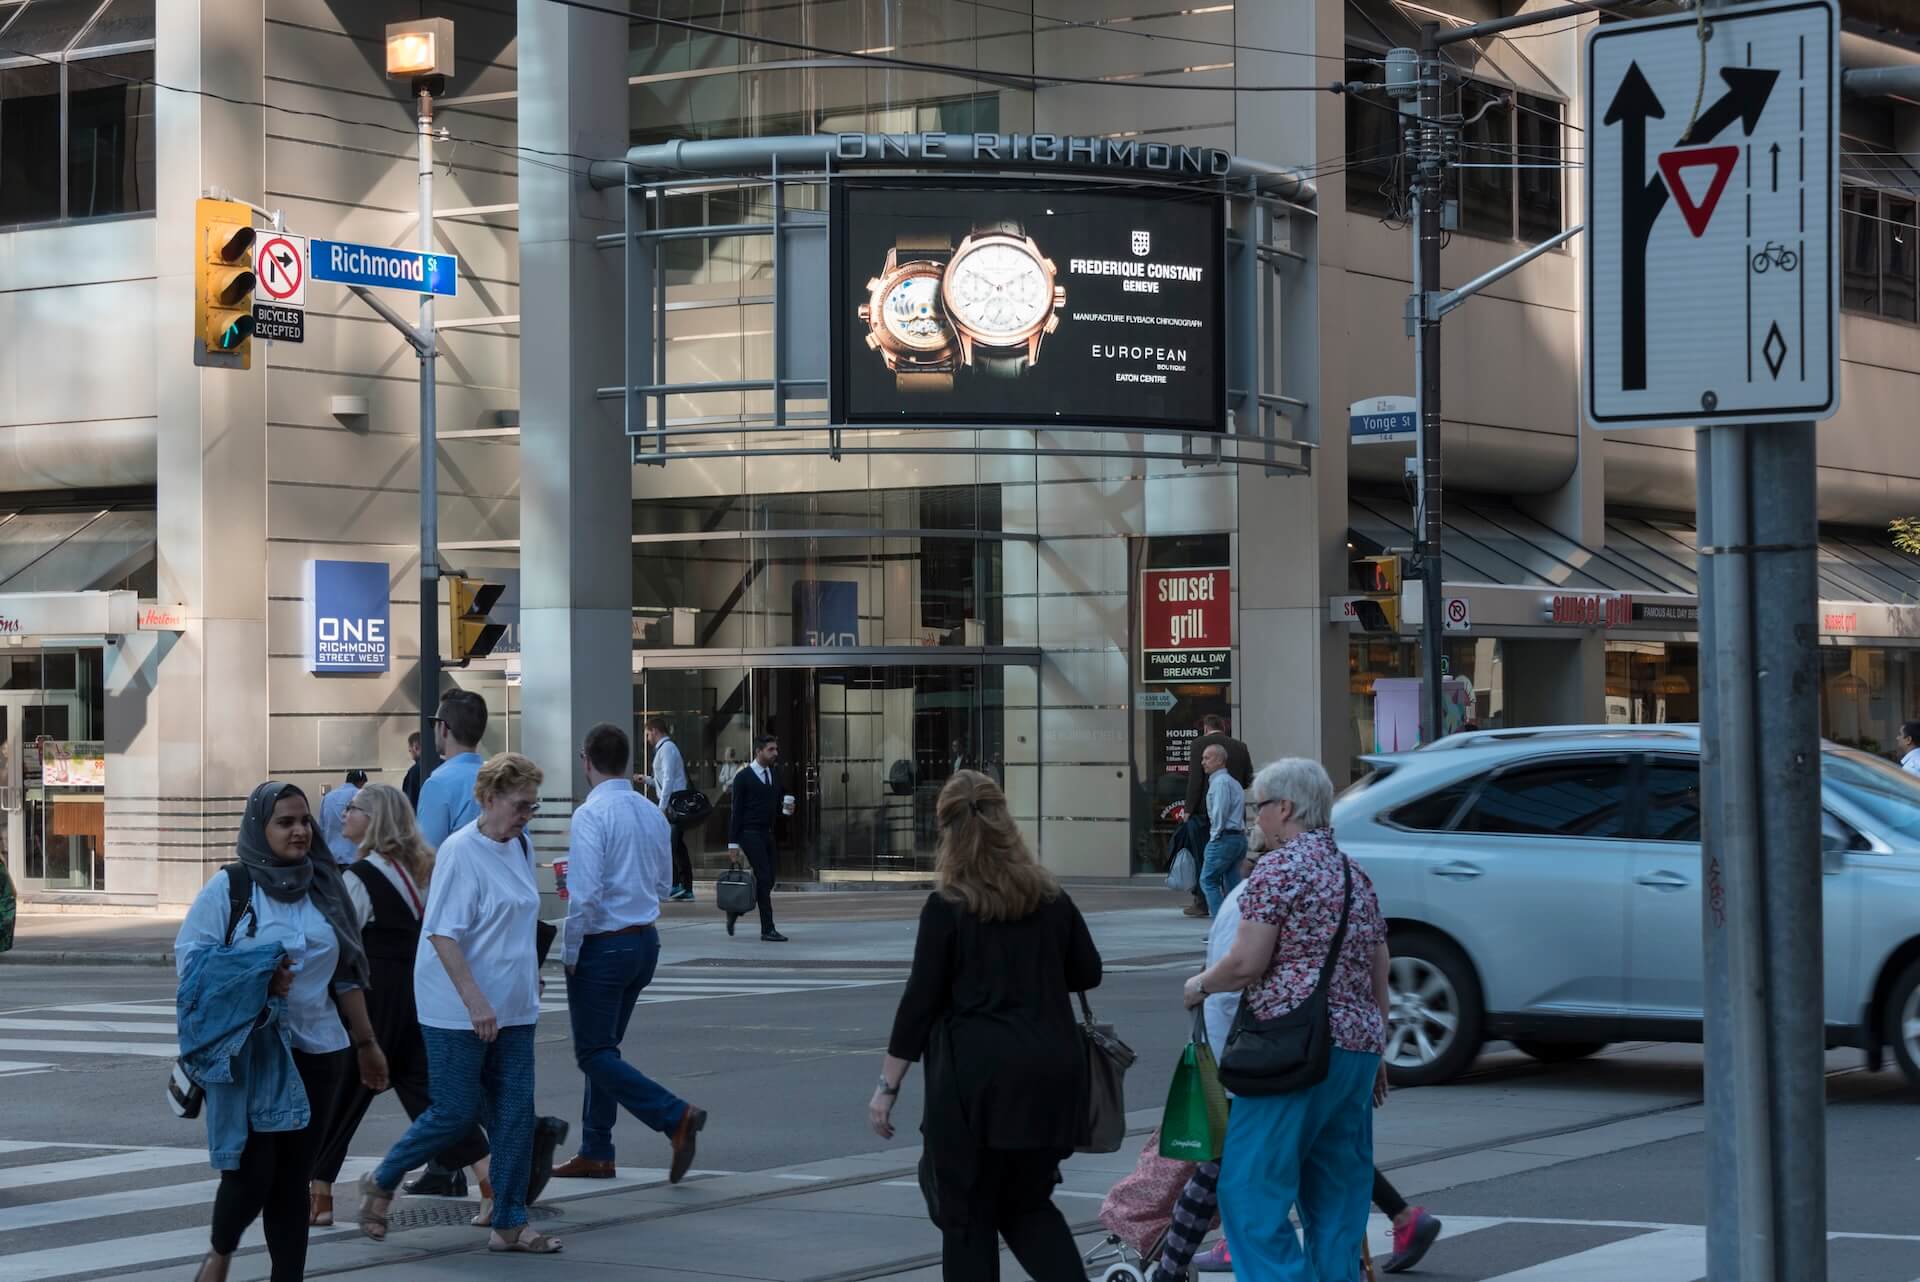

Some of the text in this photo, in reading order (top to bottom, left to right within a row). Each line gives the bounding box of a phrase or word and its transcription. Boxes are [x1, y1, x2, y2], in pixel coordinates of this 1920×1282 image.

[836, 132, 1232, 176] ONE RICHMOND
[331, 245, 438, 282] Richmond St
[1070, 259, 1203, 282] FREDERIQUE CONSTANT
[1123, 280, 1160, 293] GENEVE
[258, 308, 299, 325] BICYCLES
[1072, 312, 1125, 324] MANUFACTURE
[1126, 315, 1155, 325] FLYBACK
[256, 322, 301, 339] EXCEPTED
[1092, 344, 1187, 362] EUROPEAN
[1115, 373, 1167, 384] EATON CENTRE
[1363, 415, 1411, 431] Yonge St
[1158, 573, 1215, 602] sunset
[1552, 593, 1633, 630] sunset grill
[1643, 607, 1665, 618] FAMOUS
[319, 618, 385, 642] ONE
[319, 642, 385, 653] RICHMOND
[319, 653, 385, 663] STREET WEST
[1151, 653, 1226, 664] FAMOUS ALL DAY
[1166, 729, 1198, 737] HOURS
